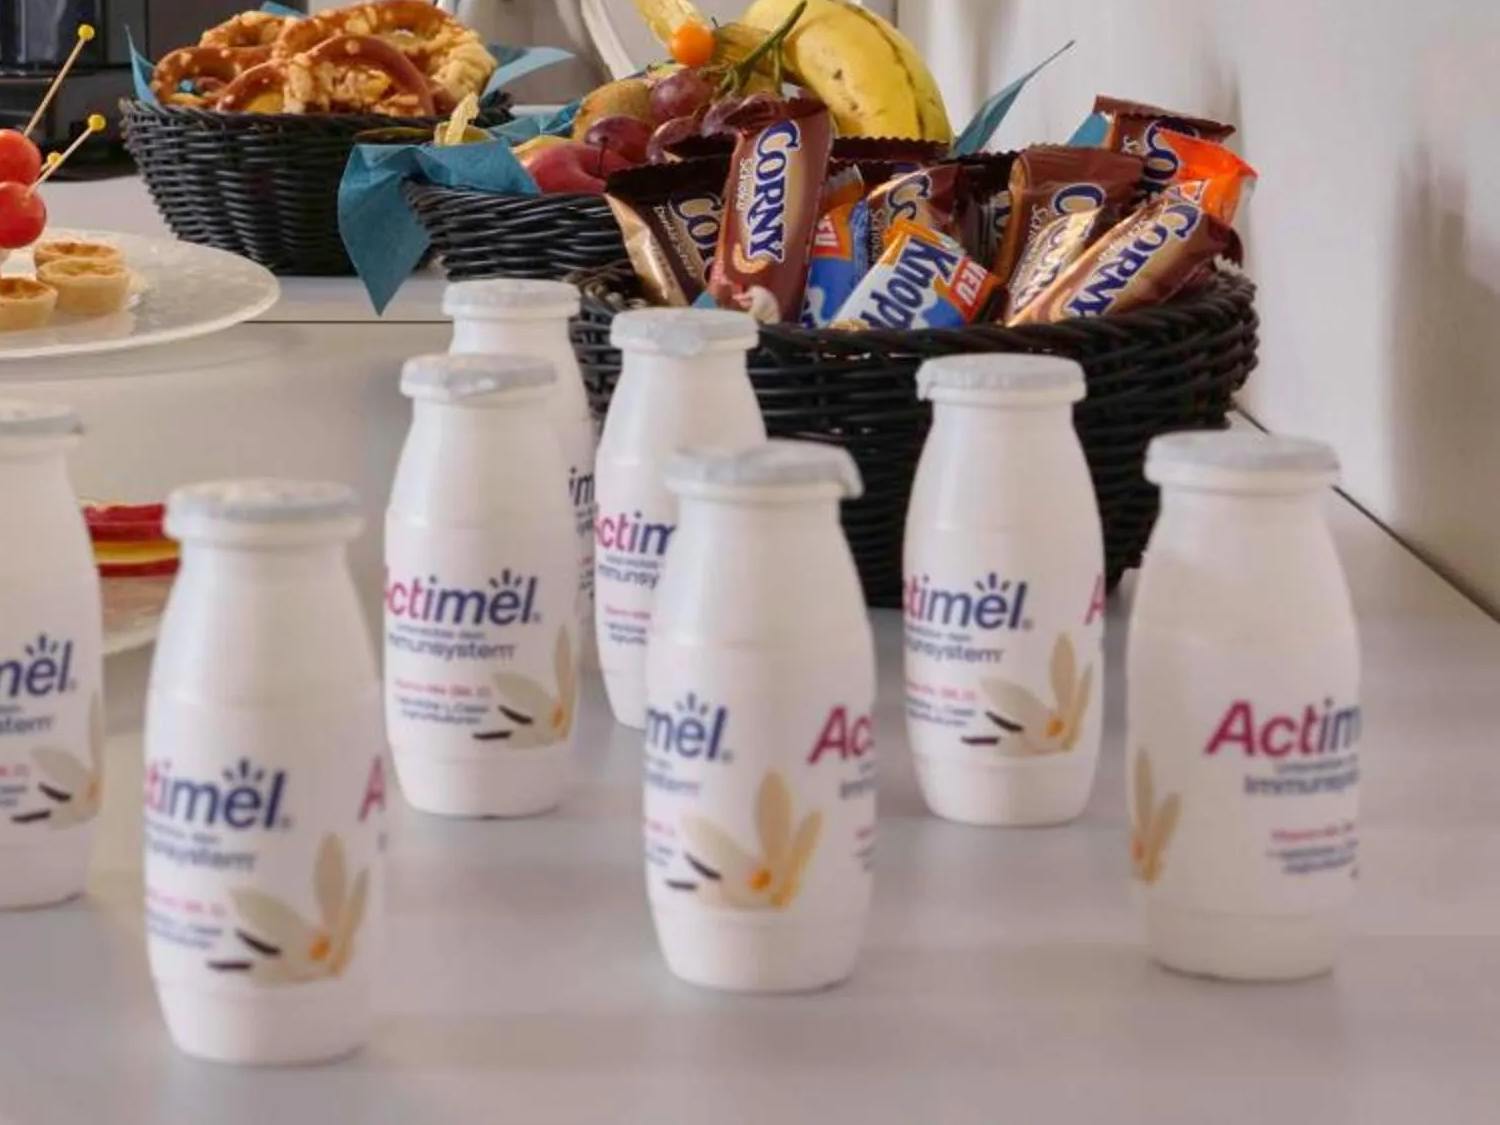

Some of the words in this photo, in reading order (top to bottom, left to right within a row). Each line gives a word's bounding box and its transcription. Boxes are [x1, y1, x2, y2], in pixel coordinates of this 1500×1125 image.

[385, 567, 538, 627] ctimel
[904, 571, 1028, 630] timel
[1203, 695, 1362, 758] Actim
[145, 757, 287, 831] timel
